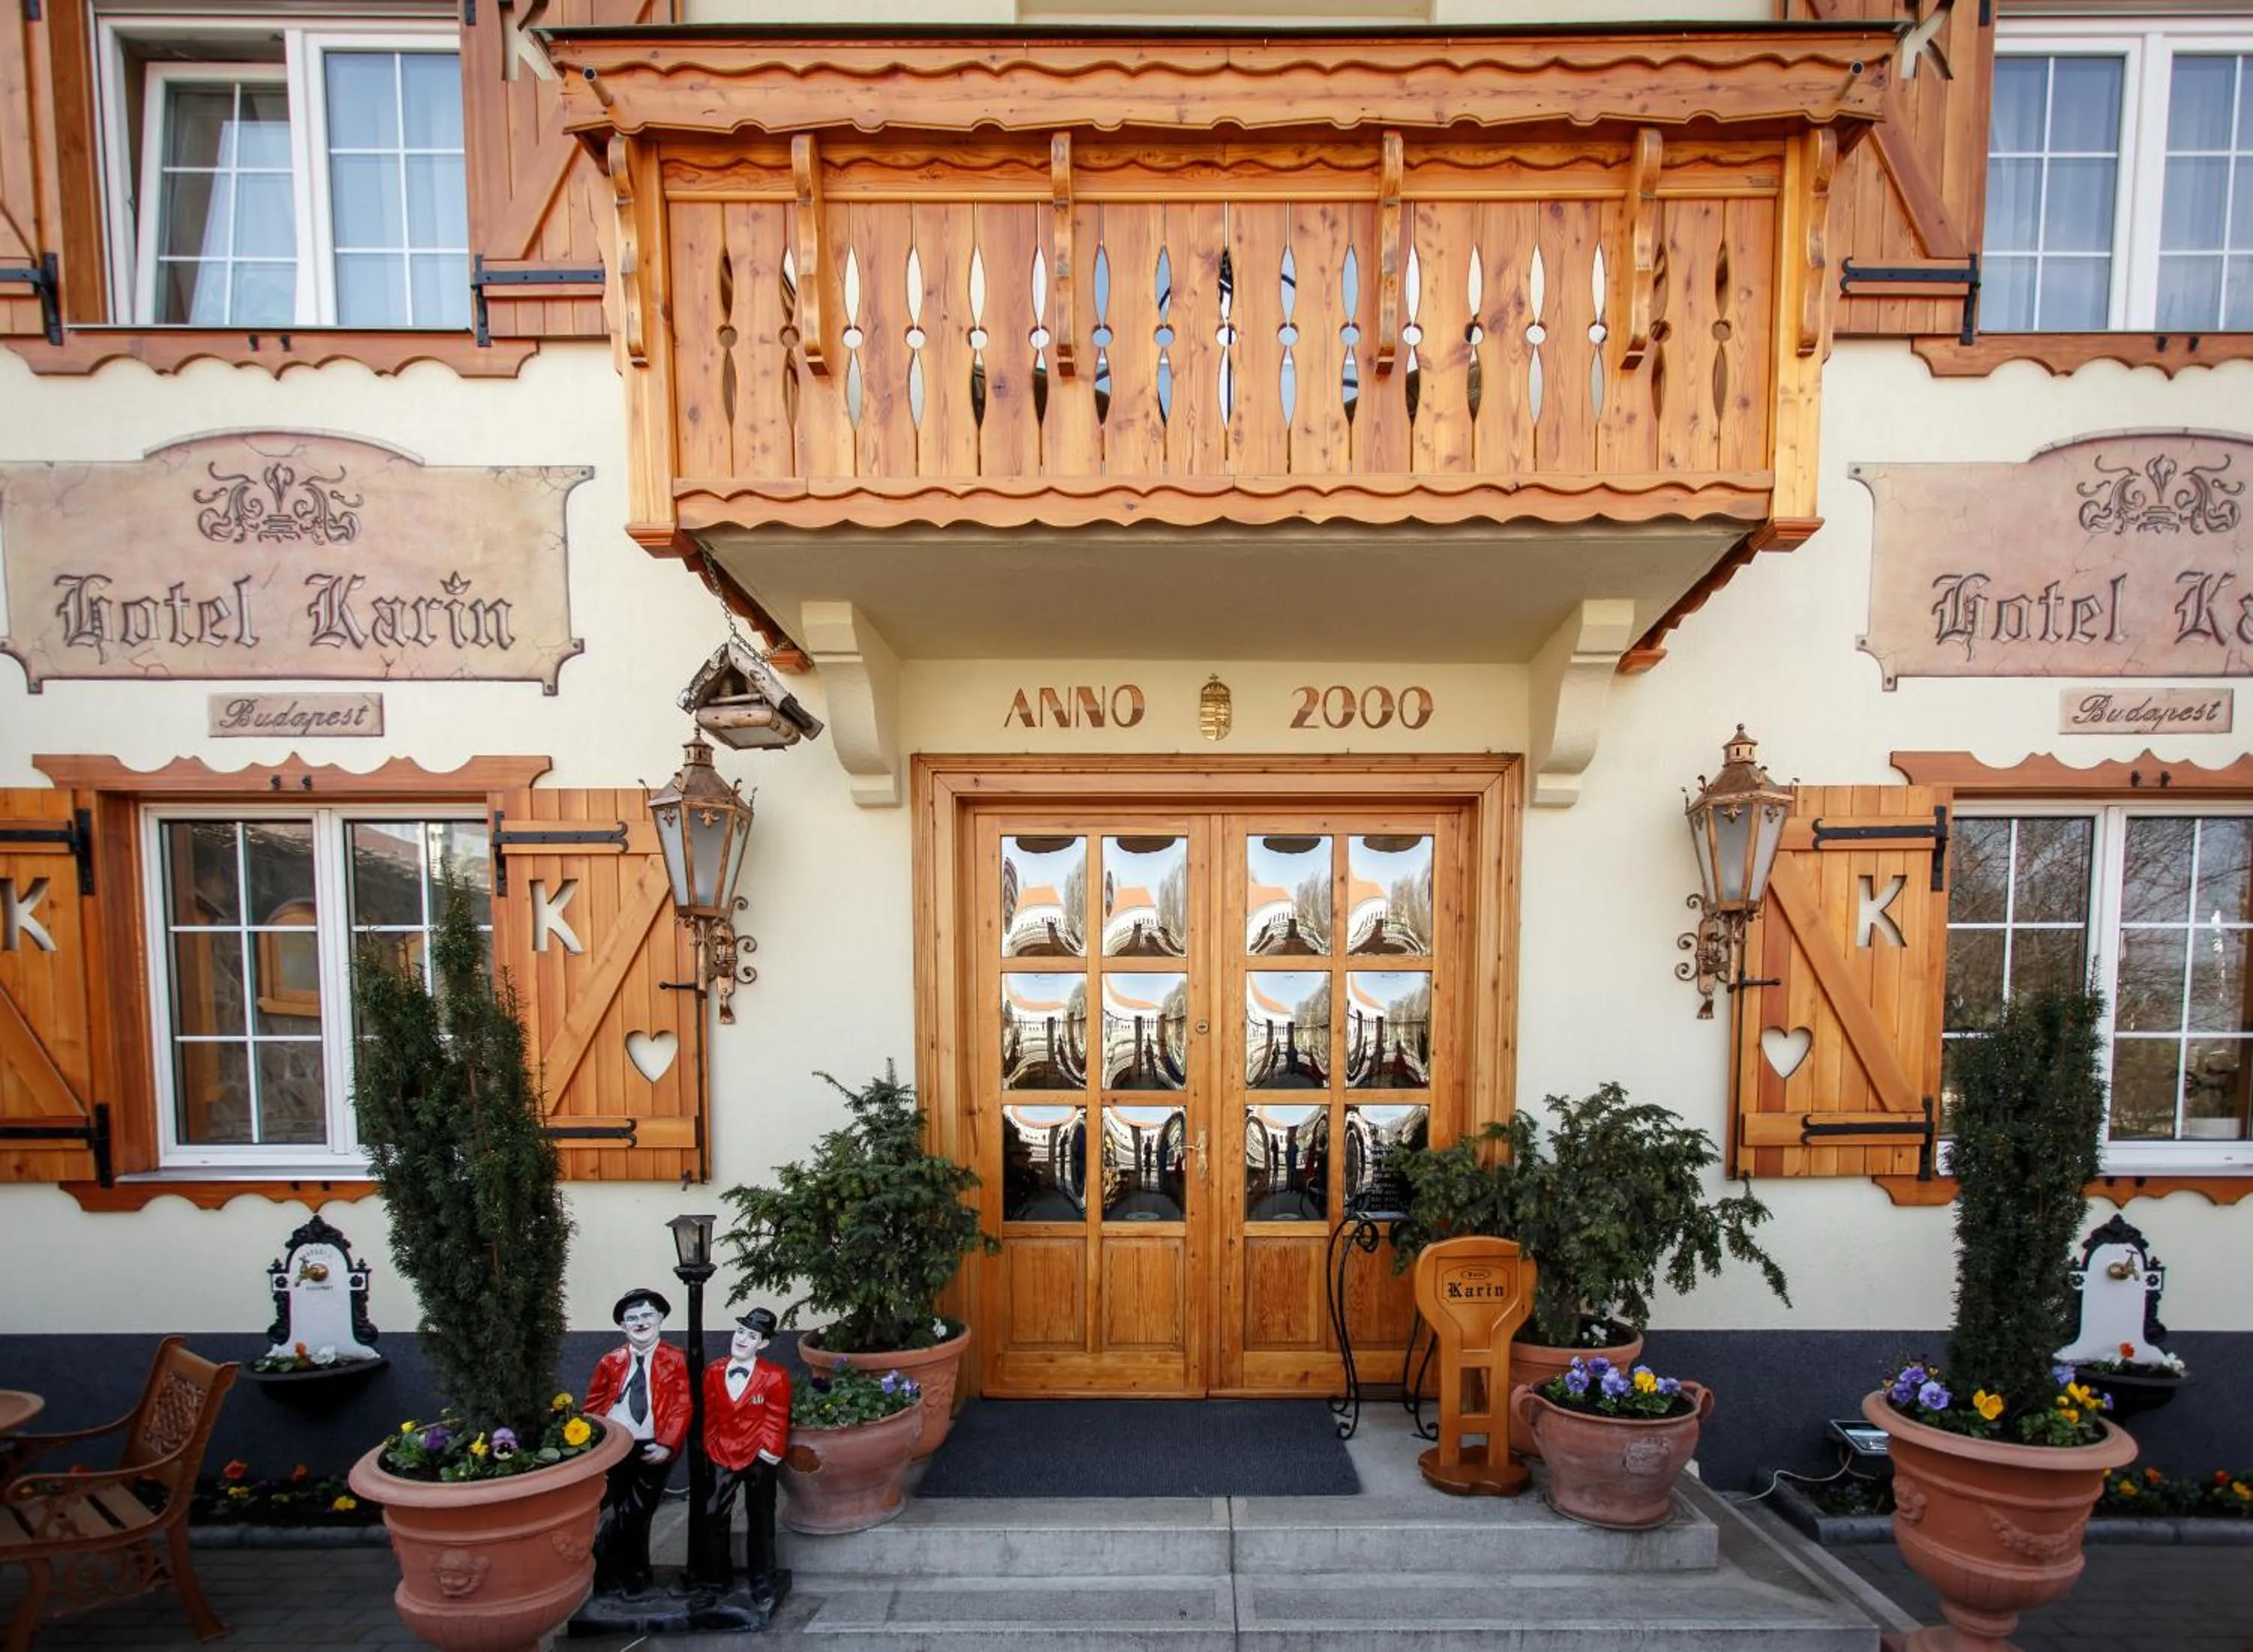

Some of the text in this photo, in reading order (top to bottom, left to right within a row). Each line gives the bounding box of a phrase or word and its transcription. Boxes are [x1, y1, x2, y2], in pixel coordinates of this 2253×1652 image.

[54, 571, 516, 665] Hotel Karin
[1932, 573, 2130, 662] Hotel
[219, 698, 370, 735] Budapest
[1004, 684, 1434, 729] ANNO 2000
[2072, 695, 2221, 731] Budapest
[0, 876, 58, 952] K
[528, 878, 585, 954] K
[1856, 874, 1908, 947] K
[1447, 1282, 1504, 1298] Karin
